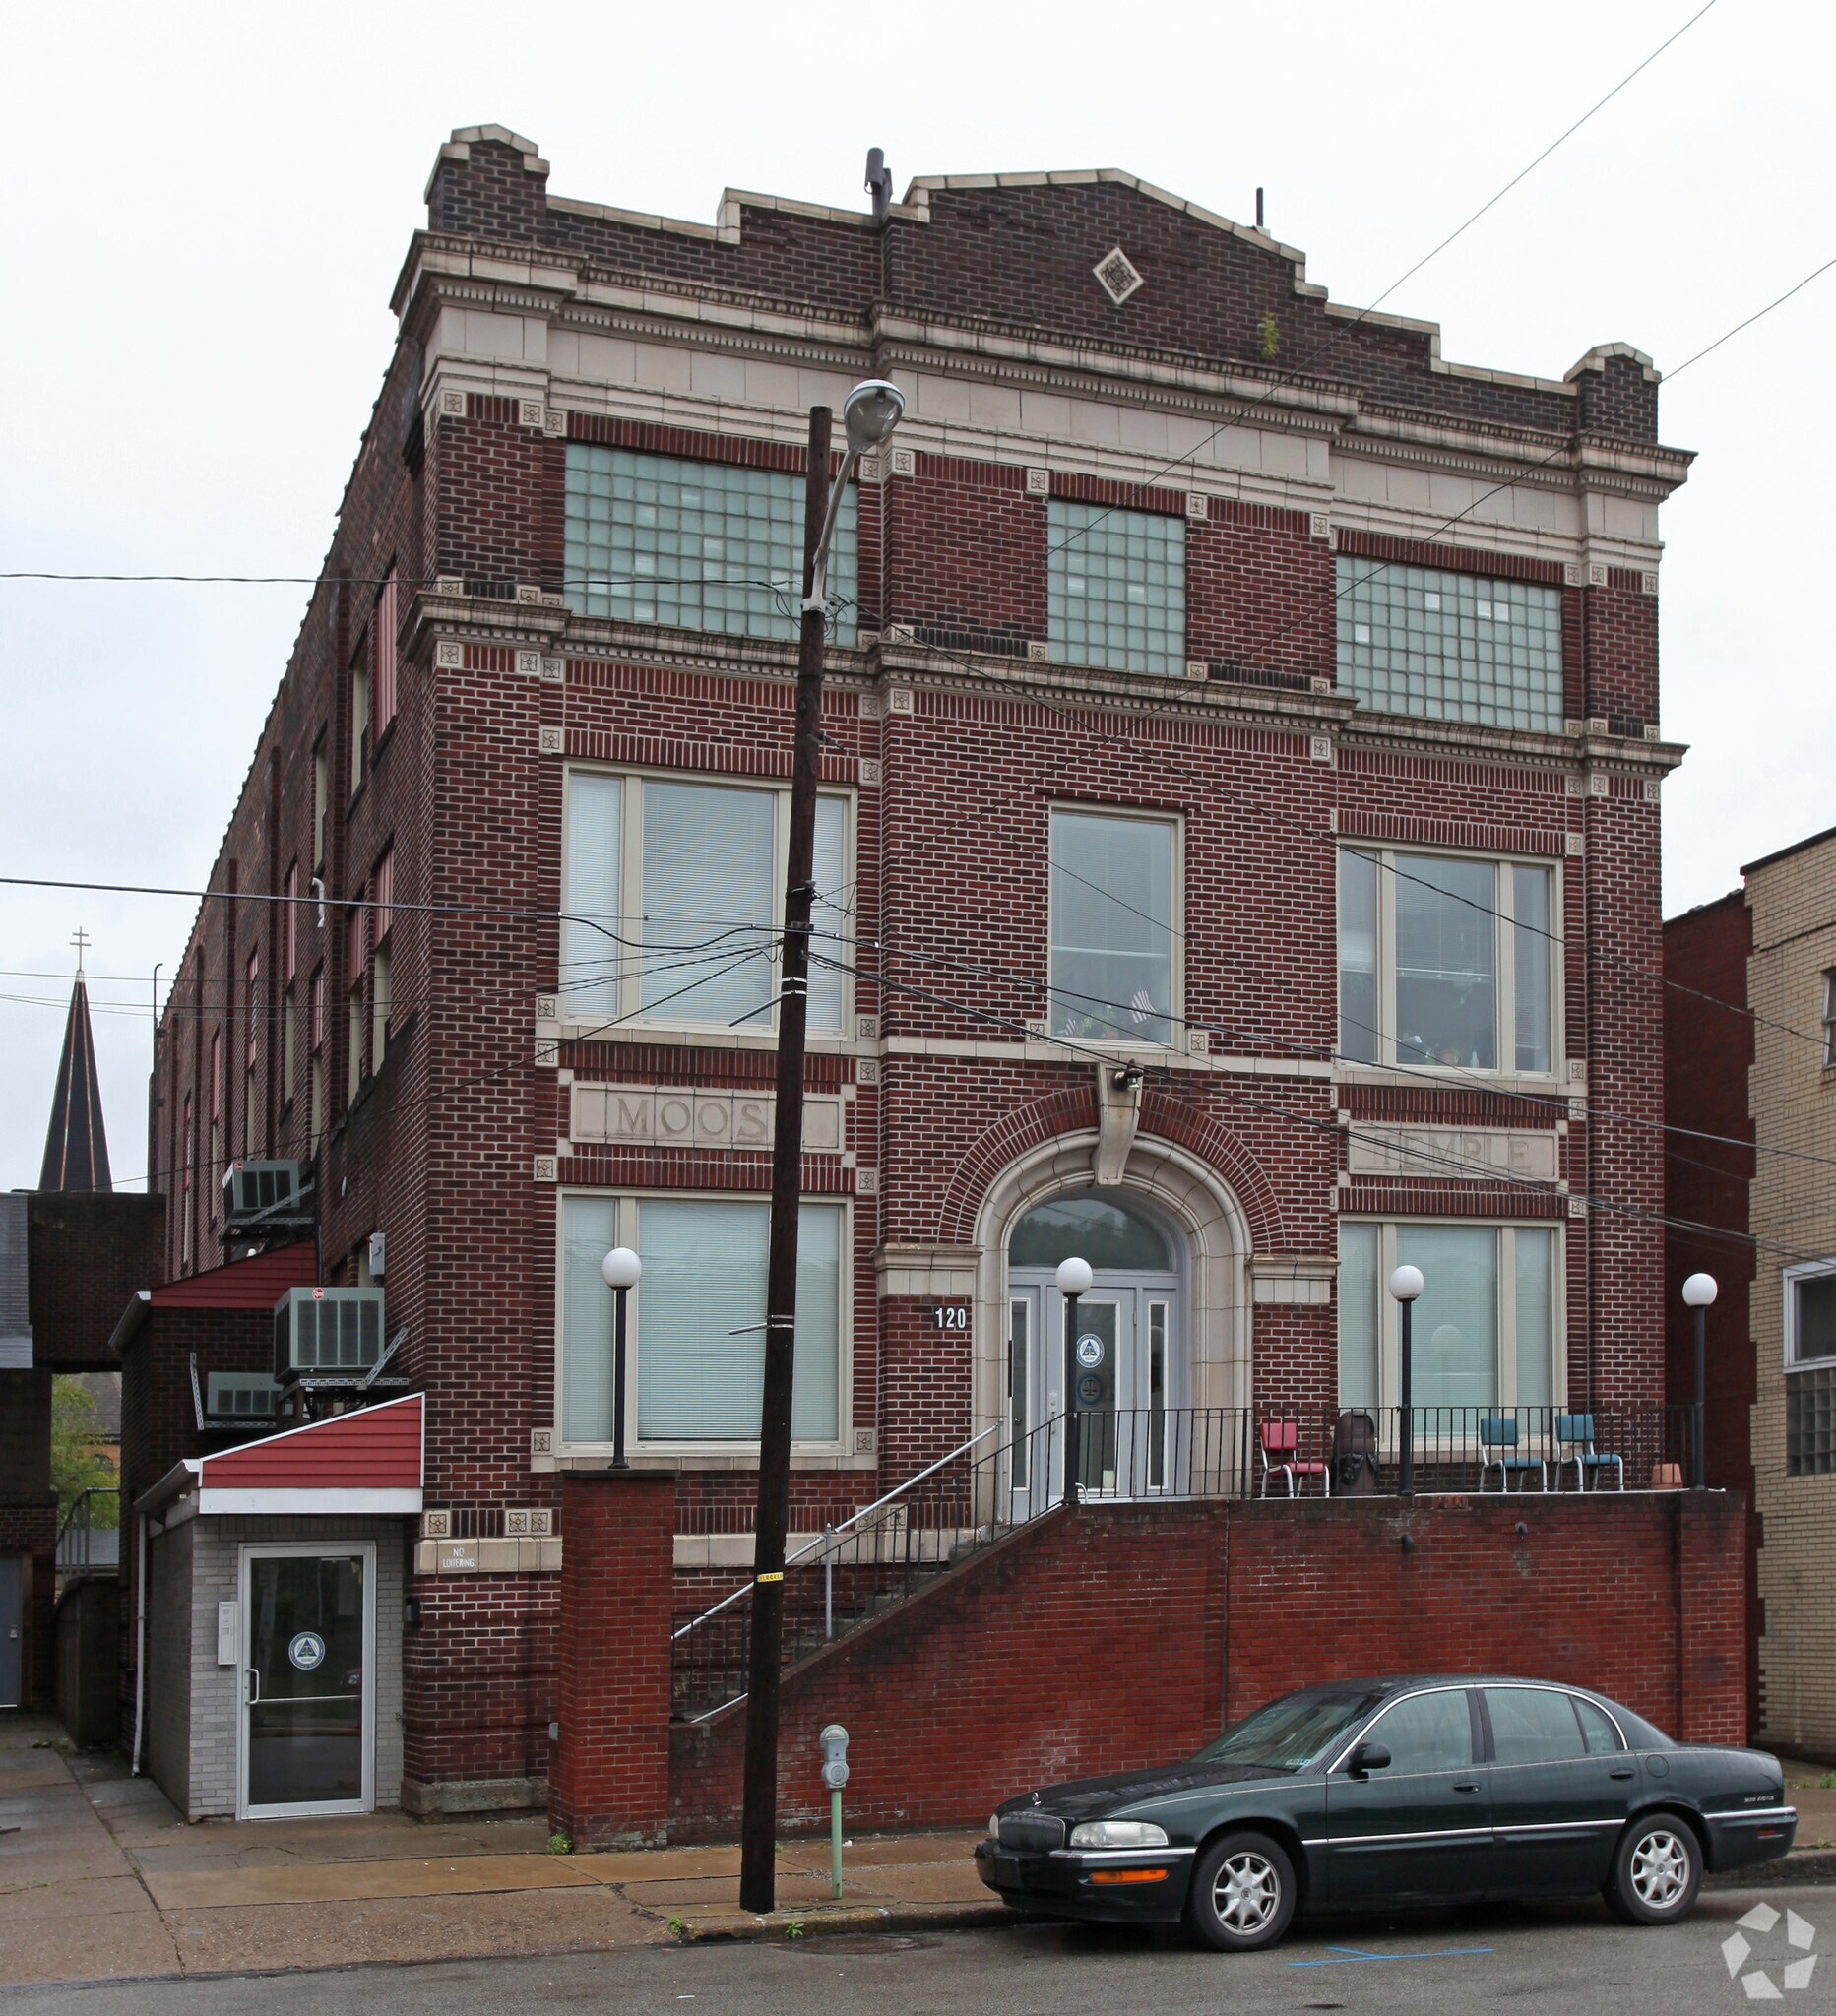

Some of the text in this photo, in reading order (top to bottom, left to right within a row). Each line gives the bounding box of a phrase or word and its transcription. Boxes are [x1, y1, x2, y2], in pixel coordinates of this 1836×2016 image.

[616, 1097, 770, 1139] MOOS
[1373, 1133, 1534, 1172] TEMPLE
[935, 1307, 967, 1329] 120
[443, 1558, 475, 1568] LOITERING
[453, 1547, 465, 1557] NO
